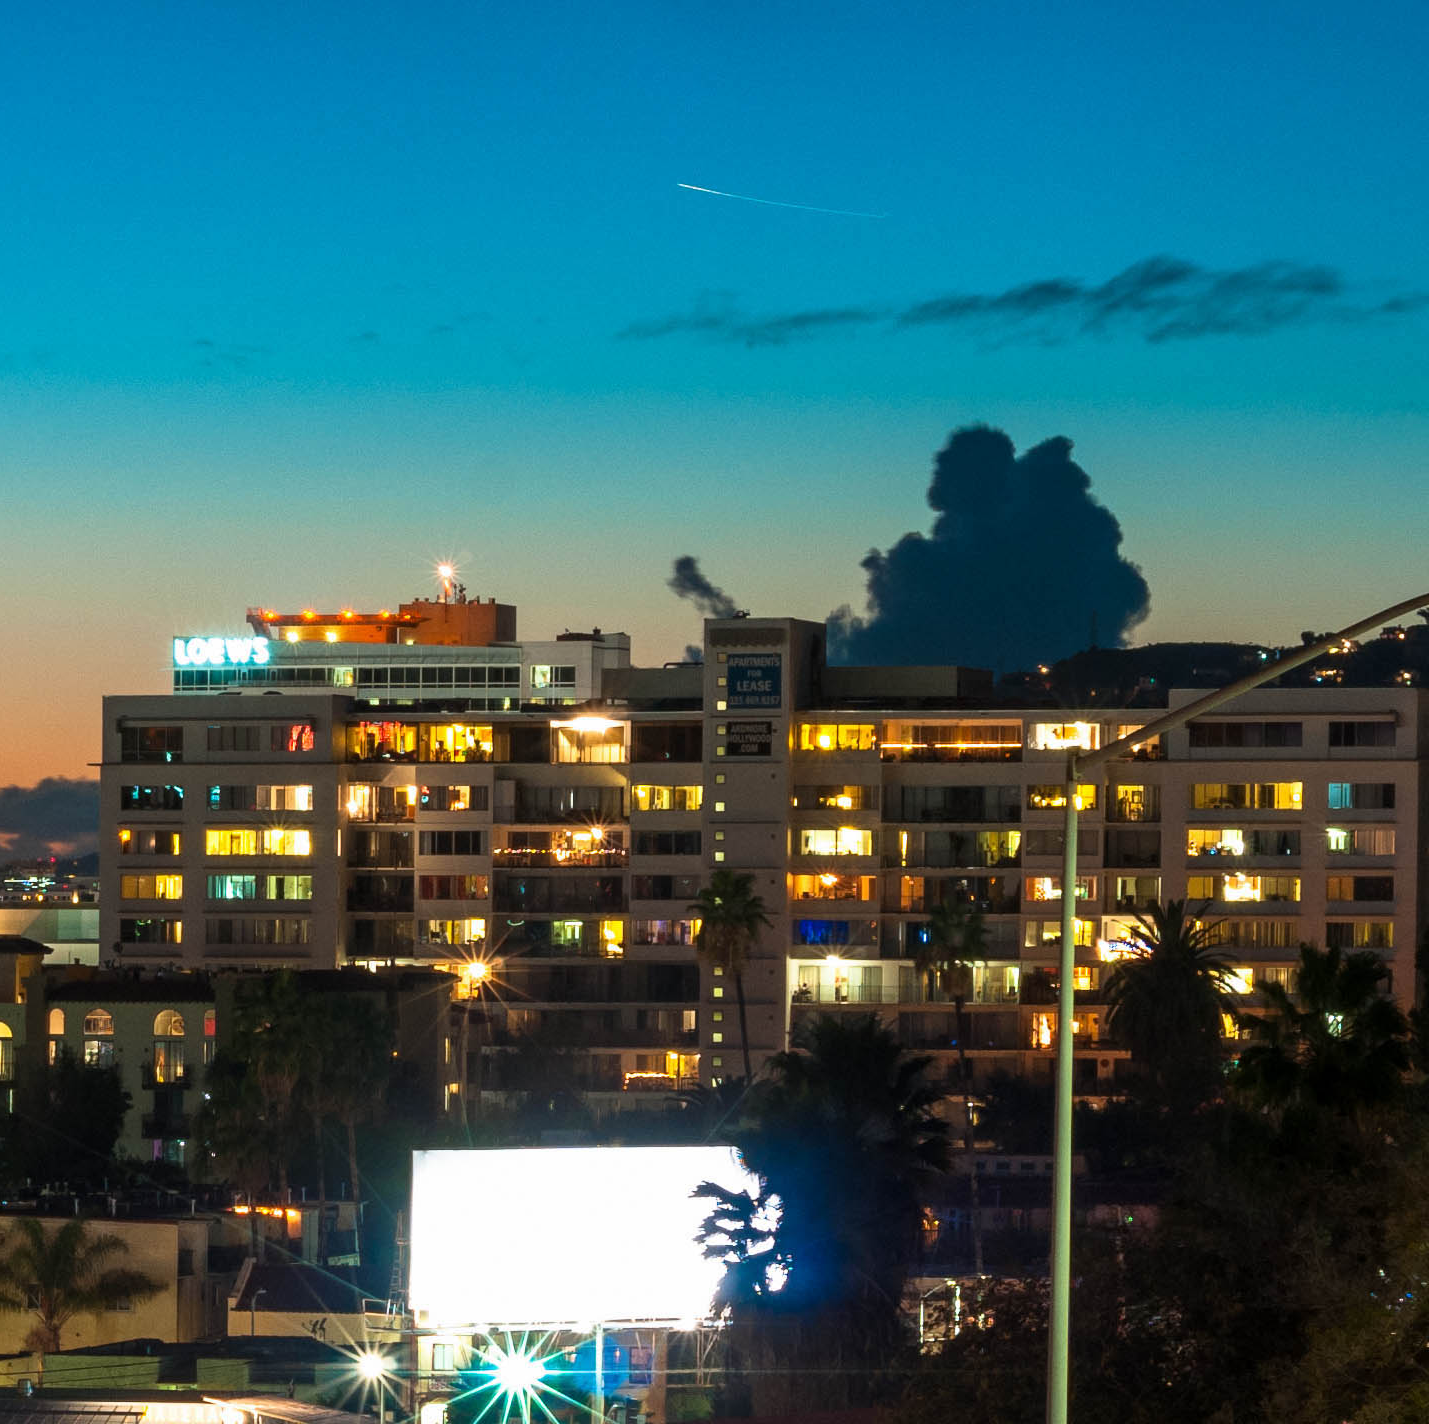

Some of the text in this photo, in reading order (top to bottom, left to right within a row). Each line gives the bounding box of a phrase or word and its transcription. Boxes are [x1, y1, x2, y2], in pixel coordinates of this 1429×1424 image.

[174, 637, 269, 665] LOEWS
[728, 657, 780, 666] APARTMENTS
[747, 669, 762, 677] FOR
[737, 680, 773, 691] LEASE
